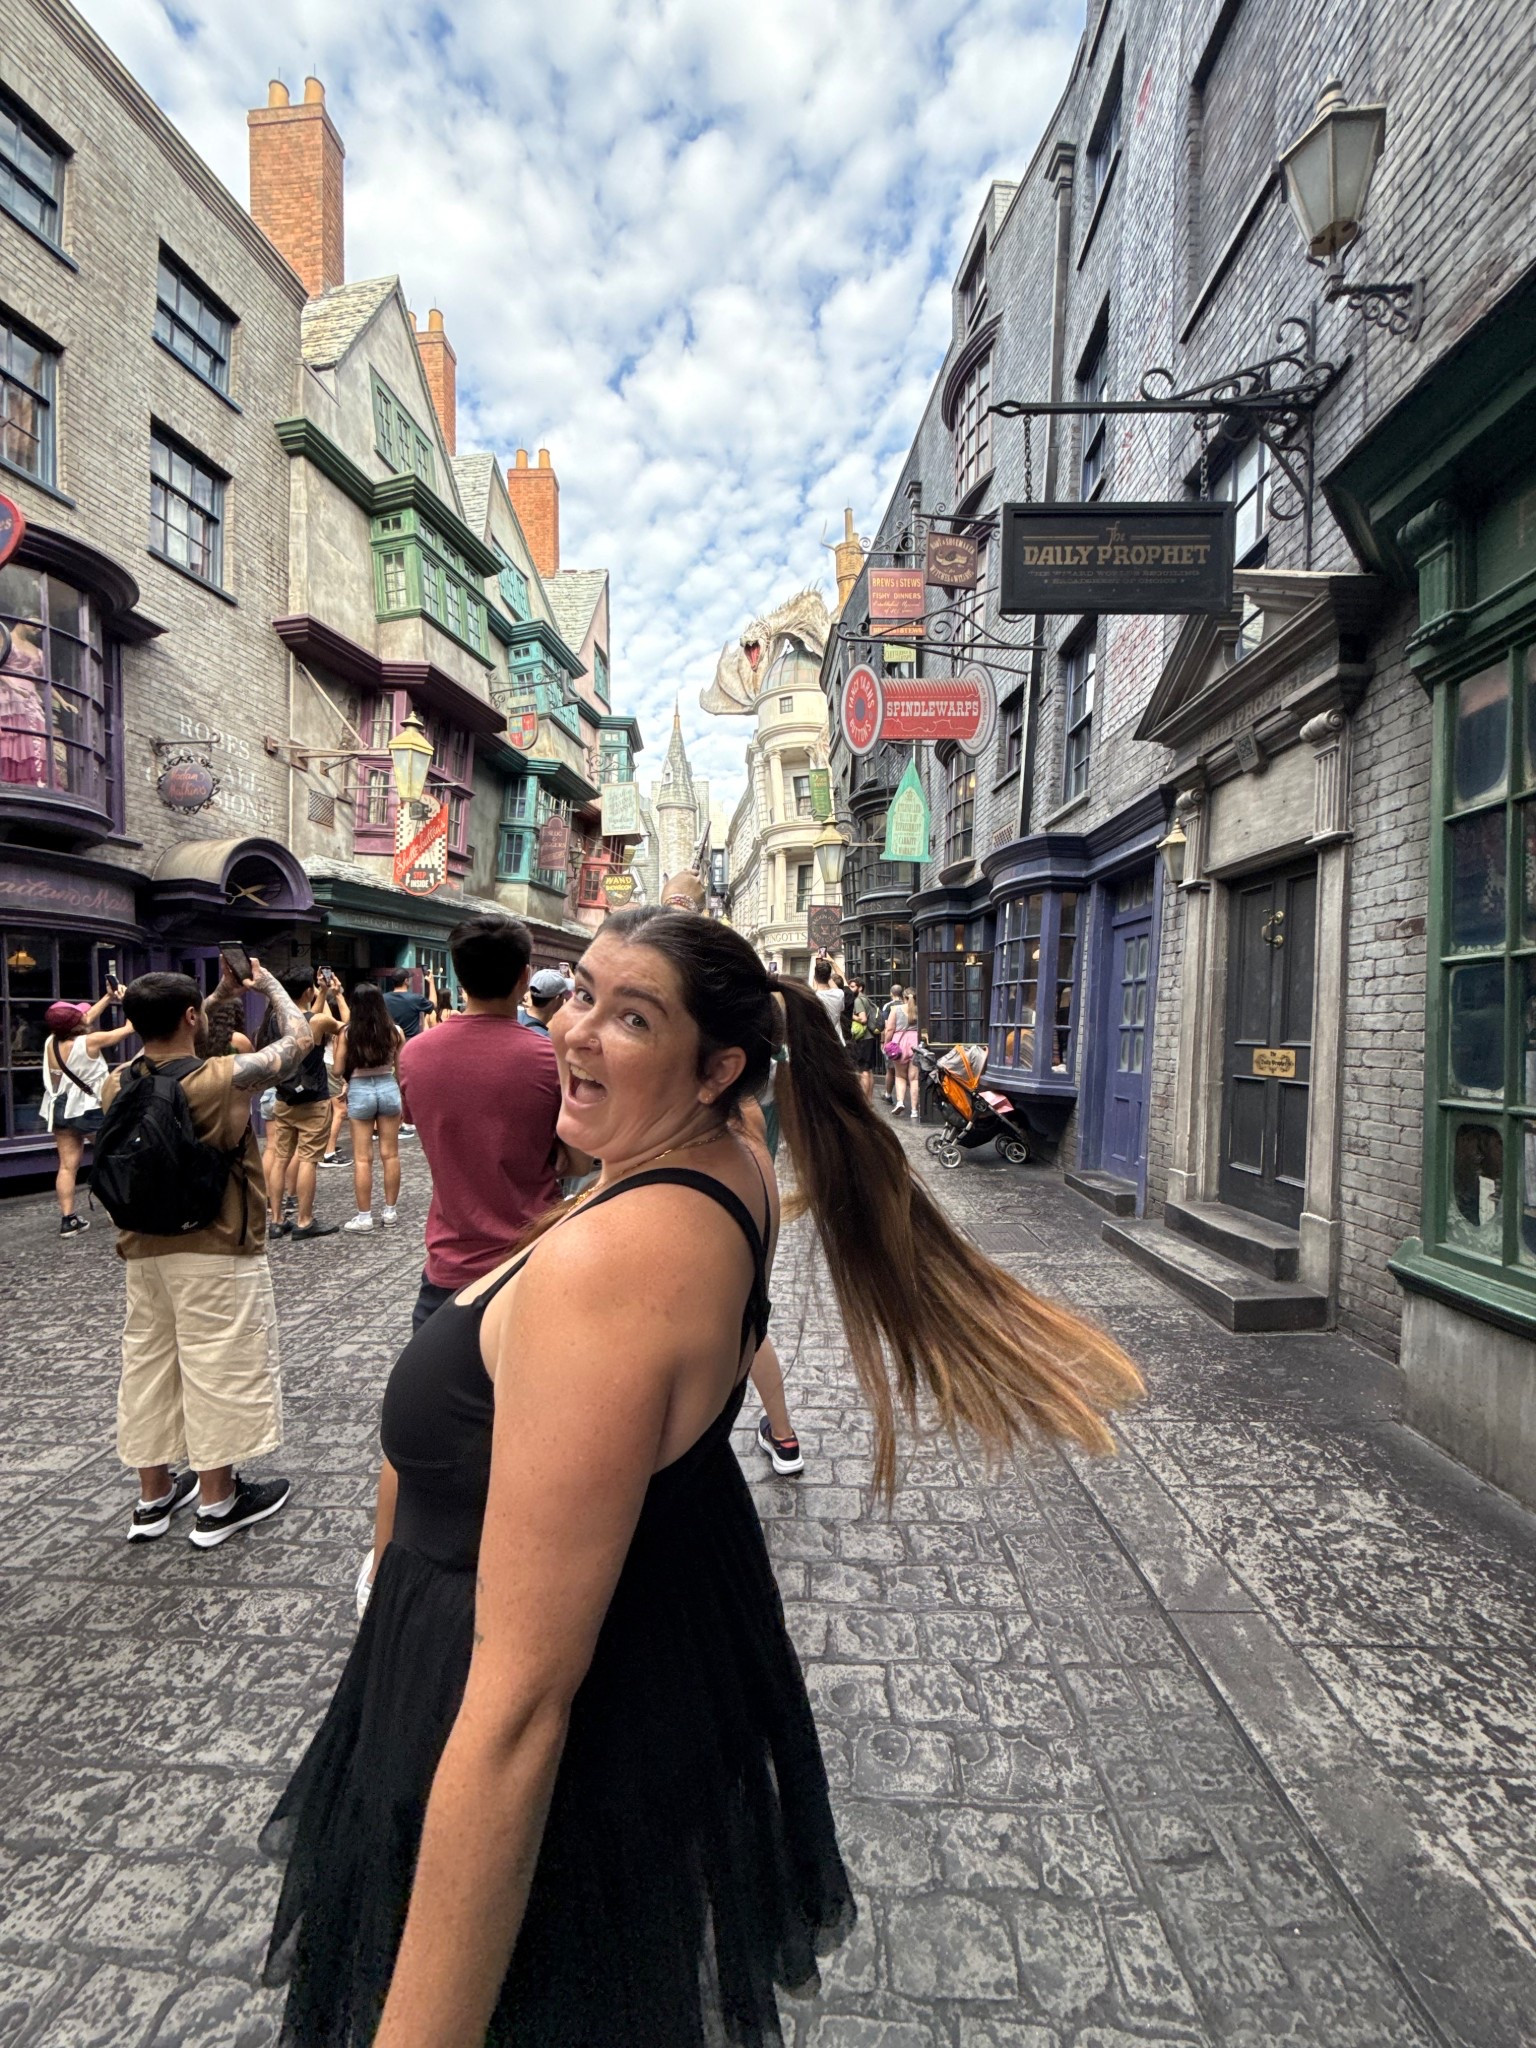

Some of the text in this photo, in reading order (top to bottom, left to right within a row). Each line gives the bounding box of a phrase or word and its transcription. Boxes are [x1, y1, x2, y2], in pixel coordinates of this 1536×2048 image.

[1106, 521, 1125, 548] The
[1023, 544, 1210, 566] DAILY PROPHET
[872, 578, 895, 587] BREWS
[900, 578, 921, 587] STEWS
[860, 676, 874, 709] YARNS
[886, 701, 979, 717] SPINDLEWARPS
[850, 718, 872, 743] BUTTONS
[413, 871, 427, 879] STEP
[605, 876, 632, 885] WAND
[410, 880, 429, 888] INSIDE
